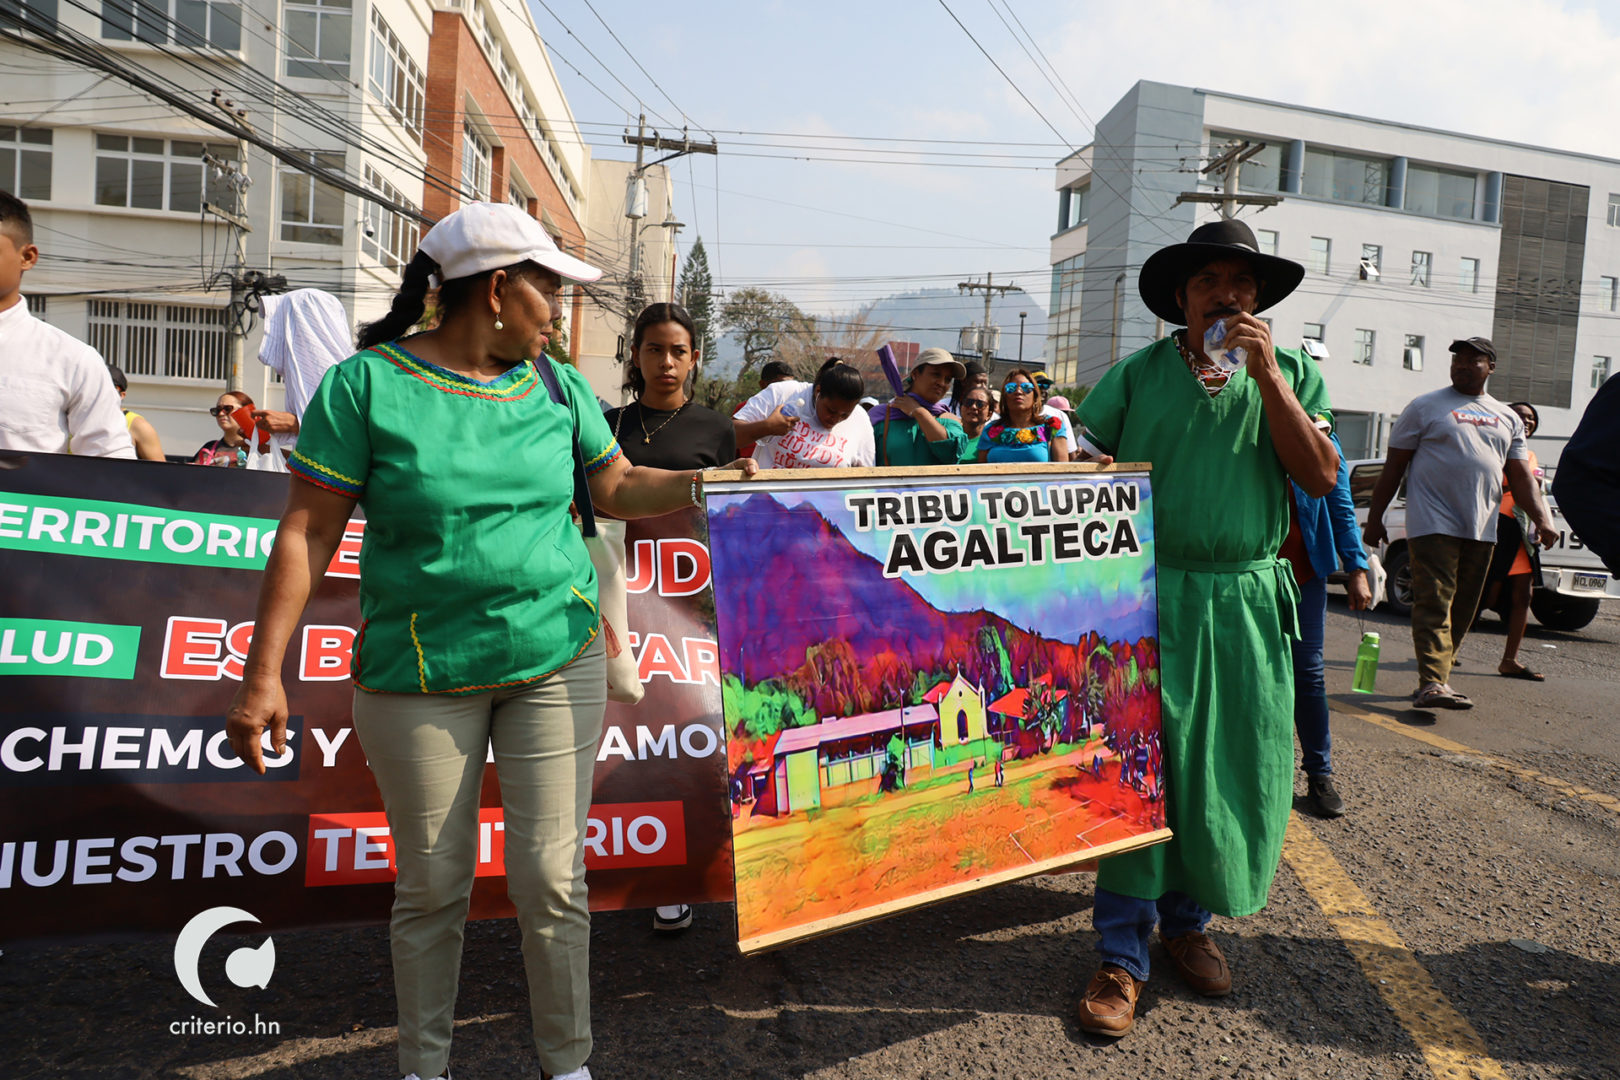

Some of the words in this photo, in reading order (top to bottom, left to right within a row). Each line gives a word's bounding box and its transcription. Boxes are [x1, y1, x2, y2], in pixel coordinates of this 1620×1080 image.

[848, 491, 970, 529] TRIBU
[979, 484, 1139, 521] TOLUPAN
[885, 517, 1141, 575] AGALTECA
[310, 727, 353, 768] Y
